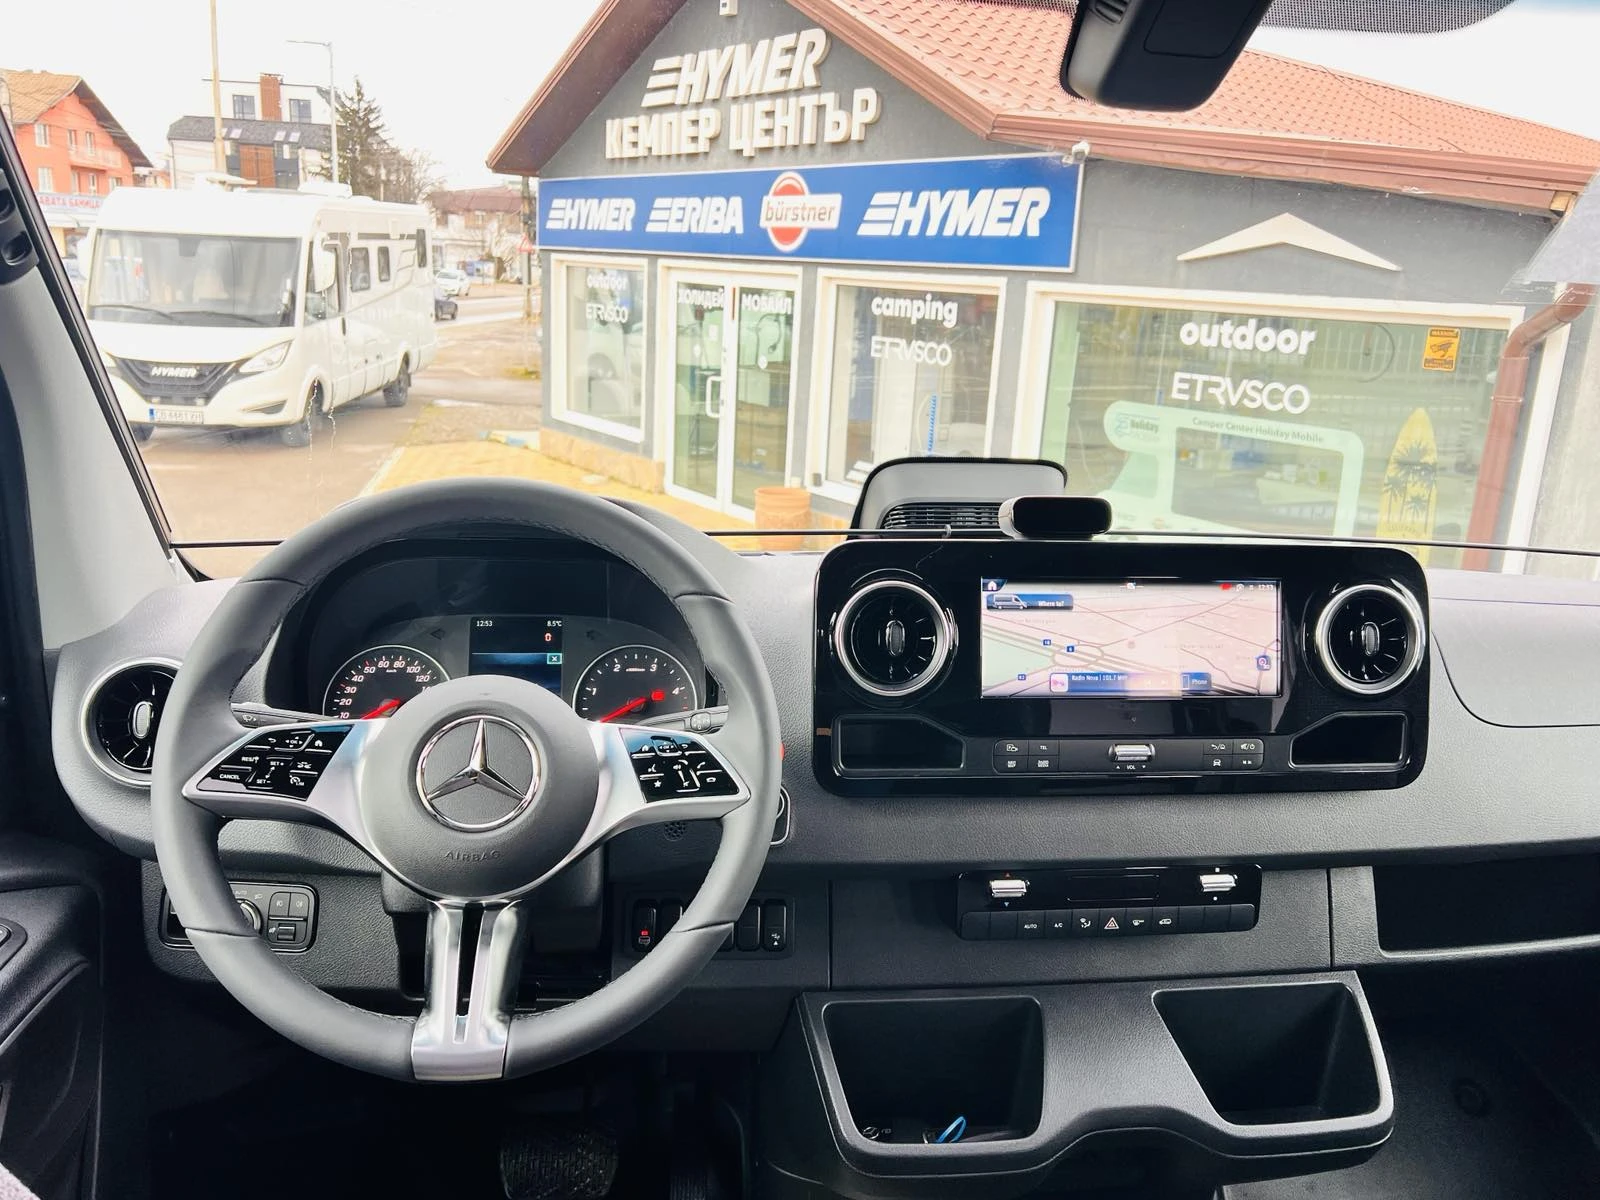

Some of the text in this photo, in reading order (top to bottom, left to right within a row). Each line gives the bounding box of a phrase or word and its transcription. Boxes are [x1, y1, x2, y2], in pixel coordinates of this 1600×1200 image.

[674, 28, 830, 106] HYMER
[605, 87, 881, 159] КЕМПЕР ЦЕНТЪР
[562, 187, 1051, 237] HYMER ERIBA bürstner HYMER
[871, 293, 958, 329] camping
[1179, 318, 1317, 356] outdoor
[151, 365, 198, 378] HYMER
[1226, 421, 1254, 433] Center
[1255, 425, 1290, 441] Holiday
[1291, 431, 1325, 443] Mobile
[363, 666, 376, 674] 50
[378, 660, 390, 668] 60
[393, 660, 405, 668] 80
[613, 663, 621, 672] 2
[650, 663, 657, 672] 3
[344, 686, 357, 694] 30
[672, 687, 680, 695] 4
[445, 849, 501, 861] AIRBAG
